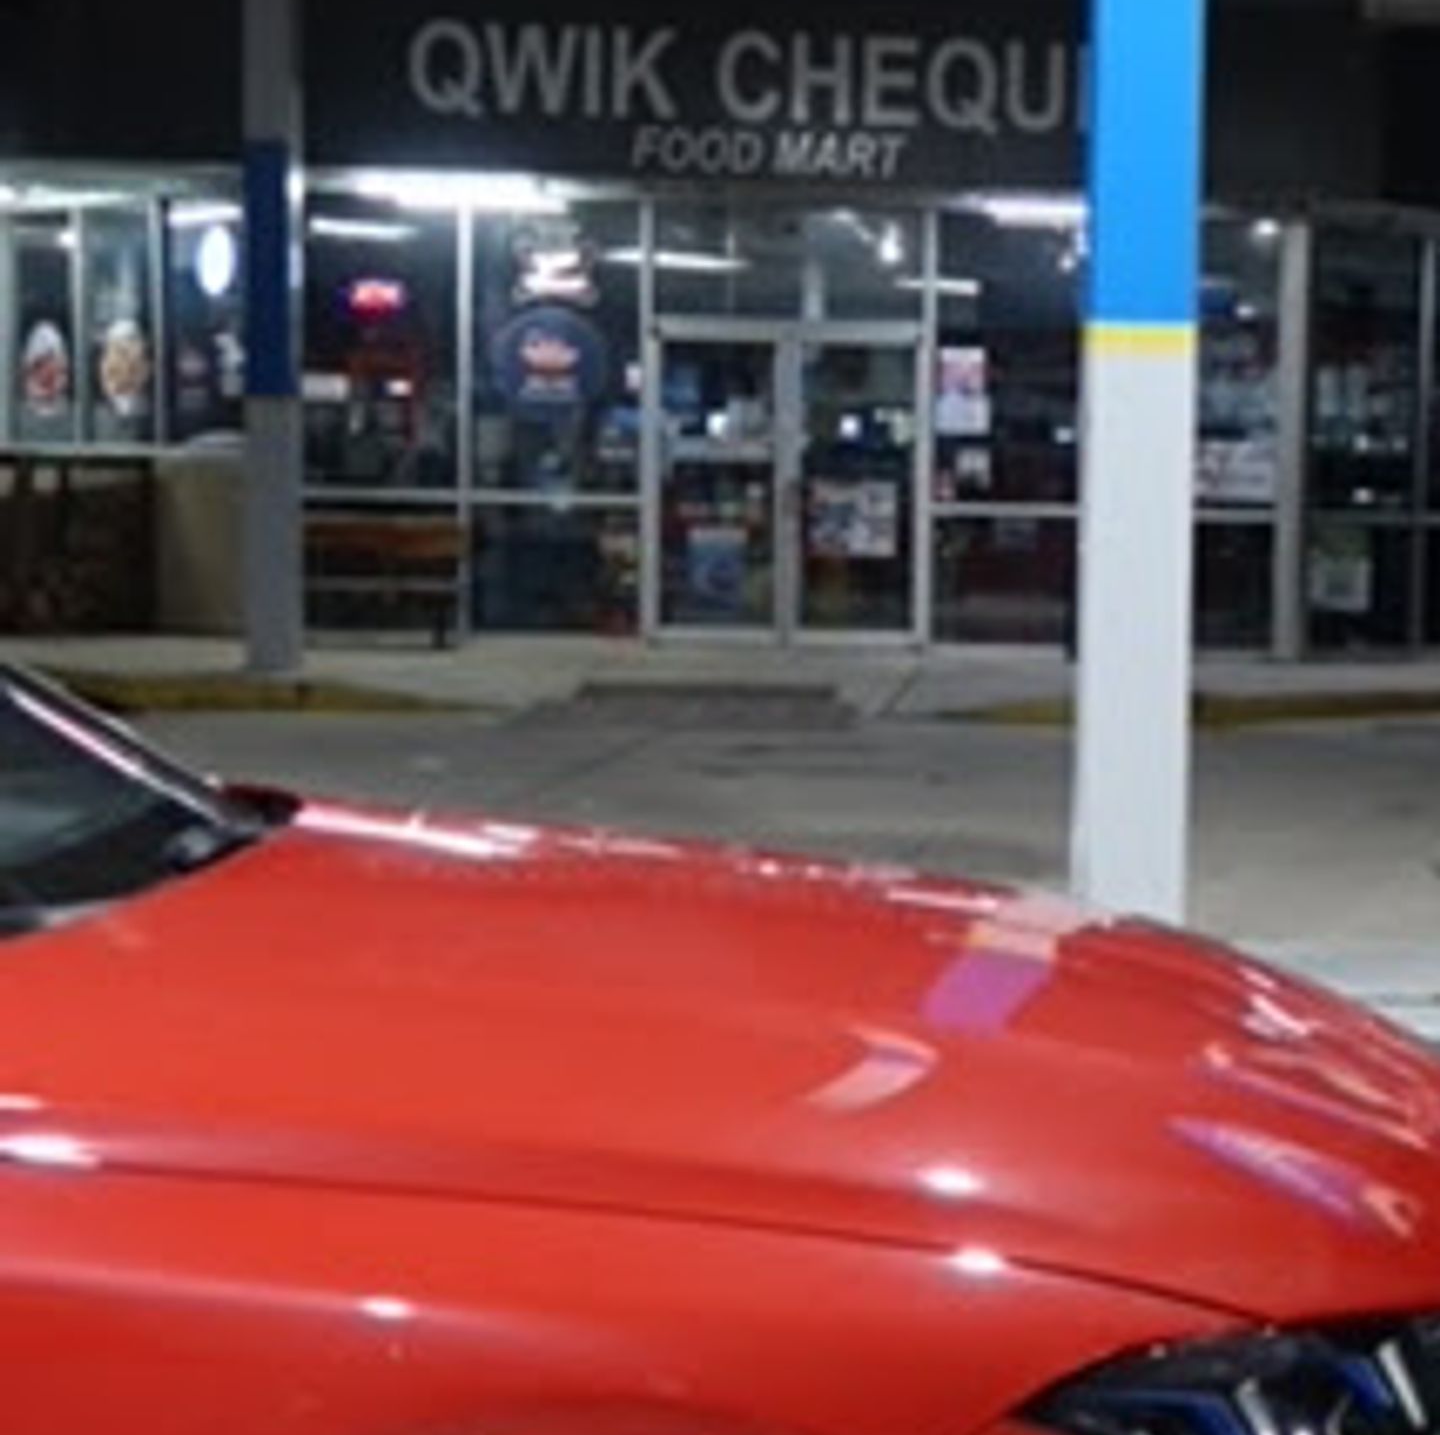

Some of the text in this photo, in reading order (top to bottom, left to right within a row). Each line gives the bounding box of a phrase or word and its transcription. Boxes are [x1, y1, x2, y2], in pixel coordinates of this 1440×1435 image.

[407, 19, 1094, 134] QWIK CHEQU
[632, 126, 908, 179] FOOD MART
